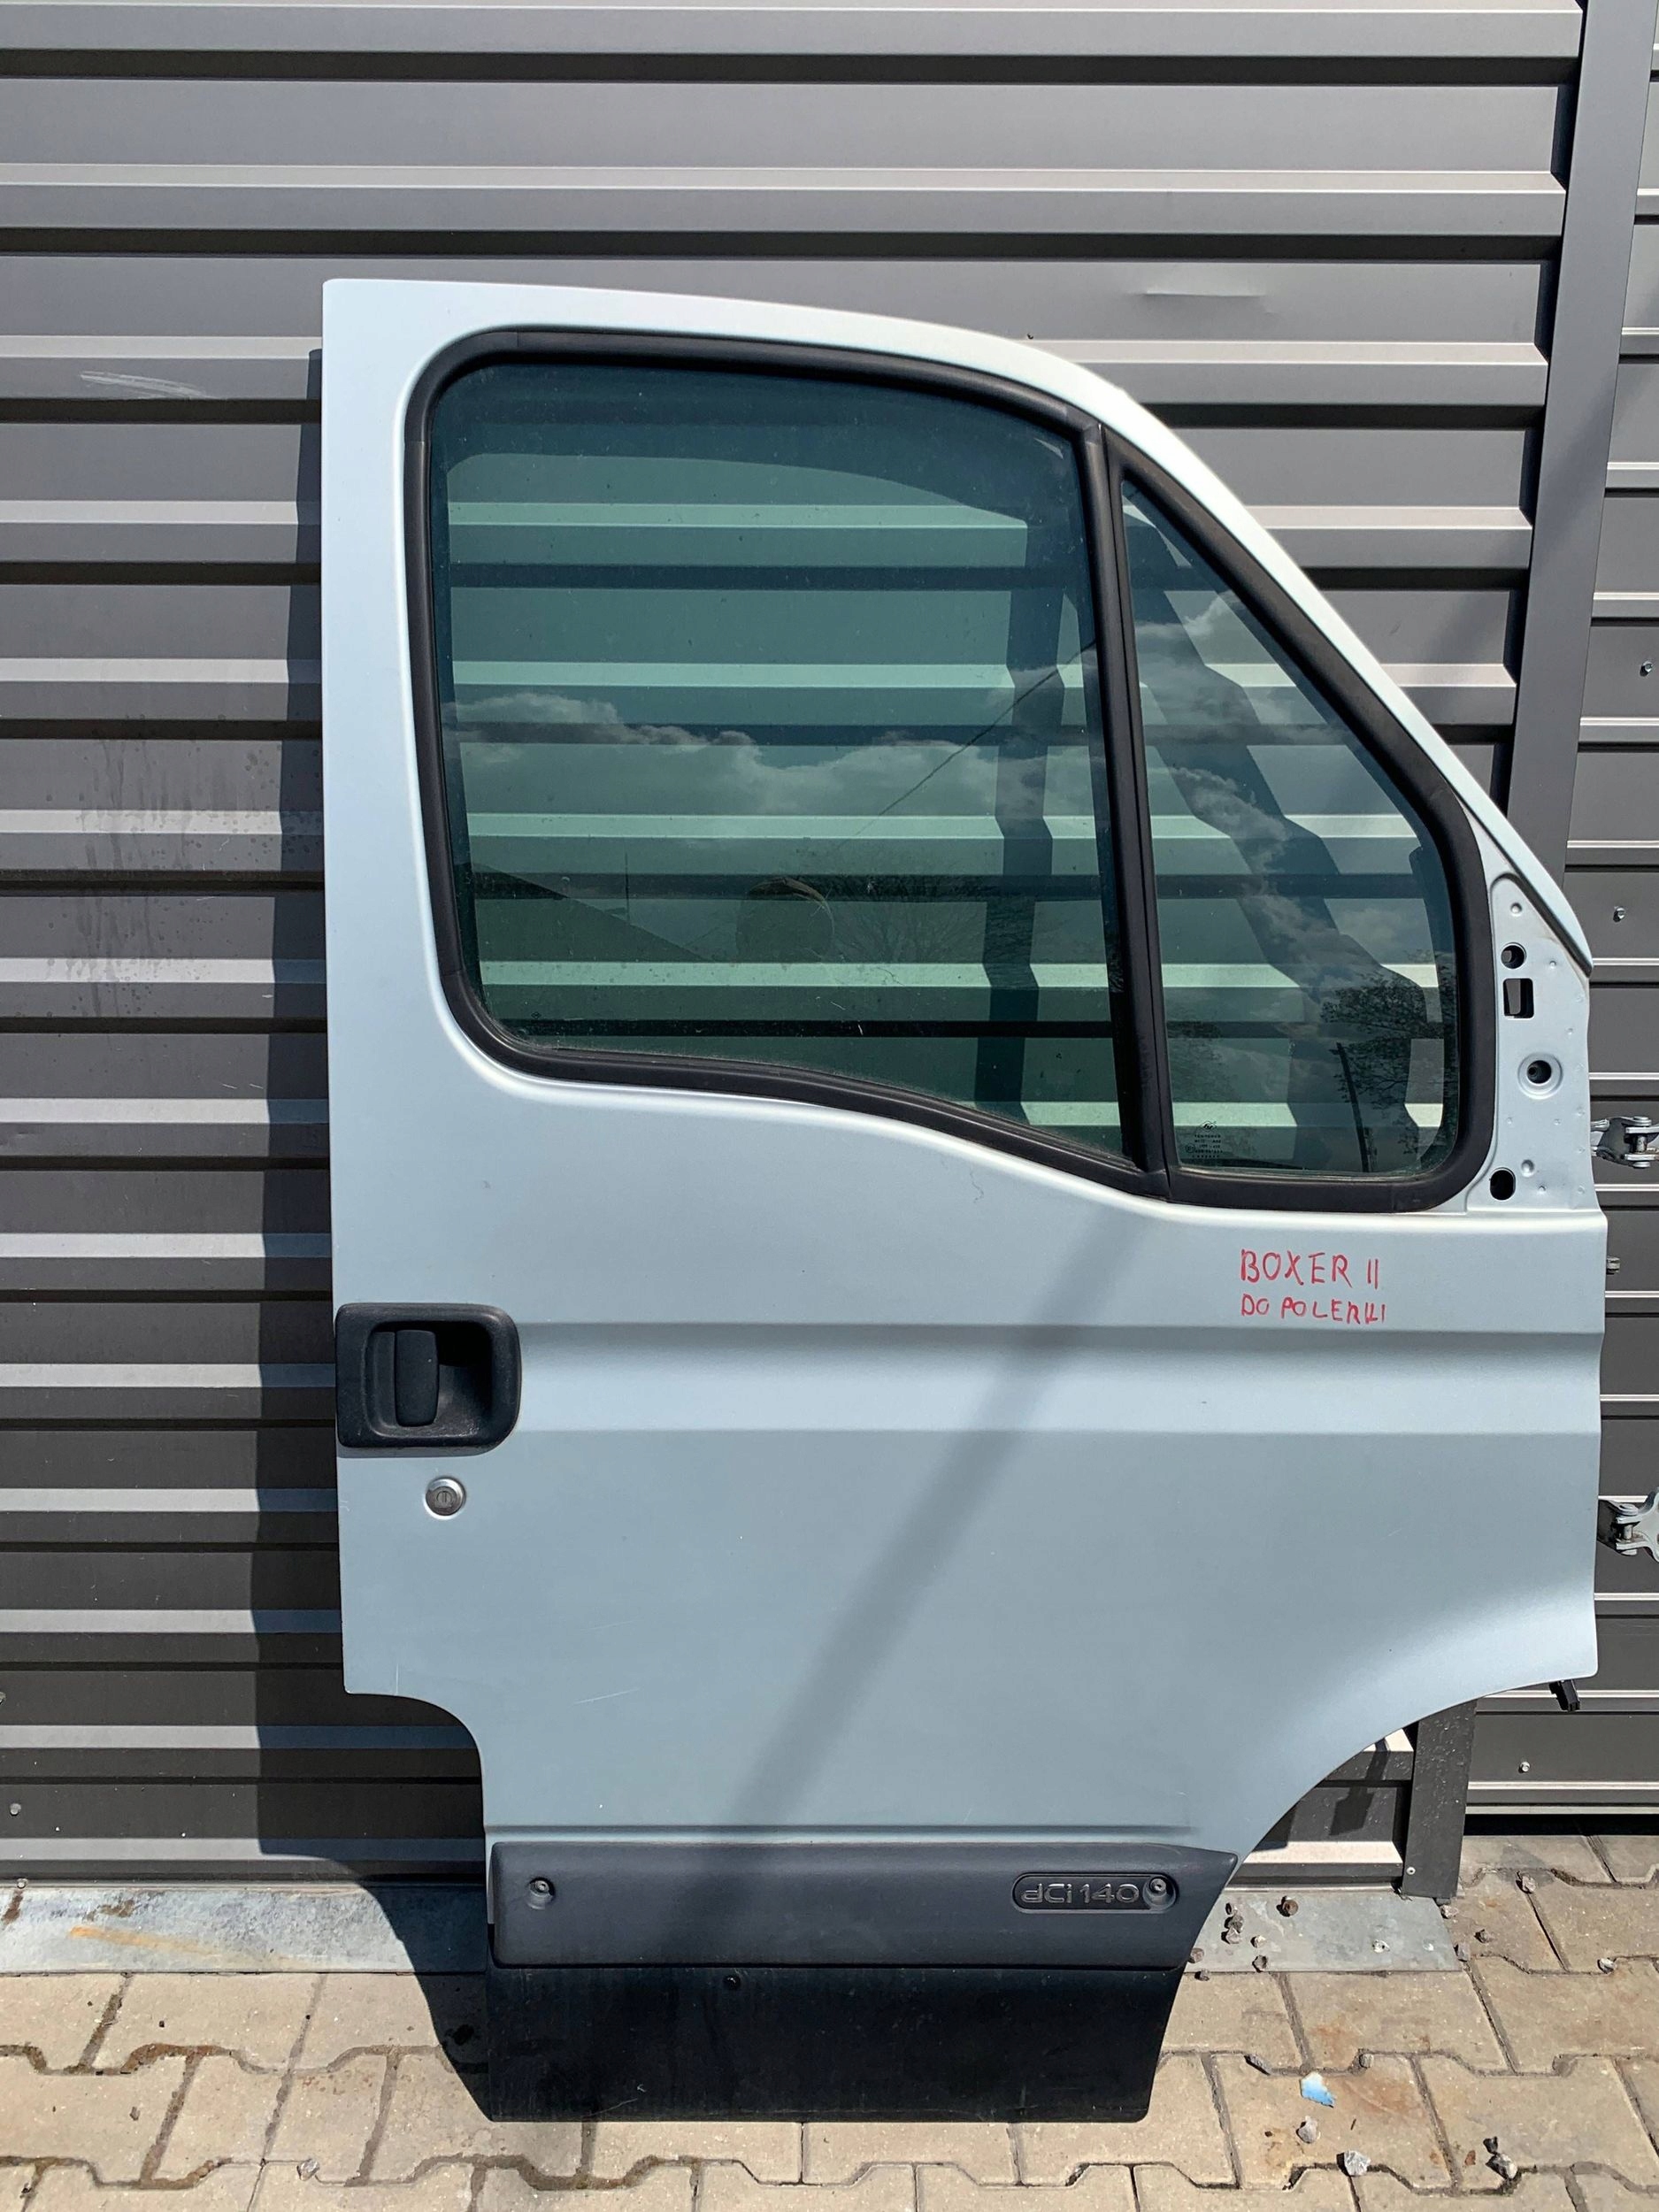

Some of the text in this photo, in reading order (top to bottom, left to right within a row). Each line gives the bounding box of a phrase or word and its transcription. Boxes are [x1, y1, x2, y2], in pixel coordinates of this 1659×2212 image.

[1240, 1248, 1353, 1288] BOXER
[1241, 1293, 1270, 1317] DO
[1079, 1883, 1141, 1903] 140
